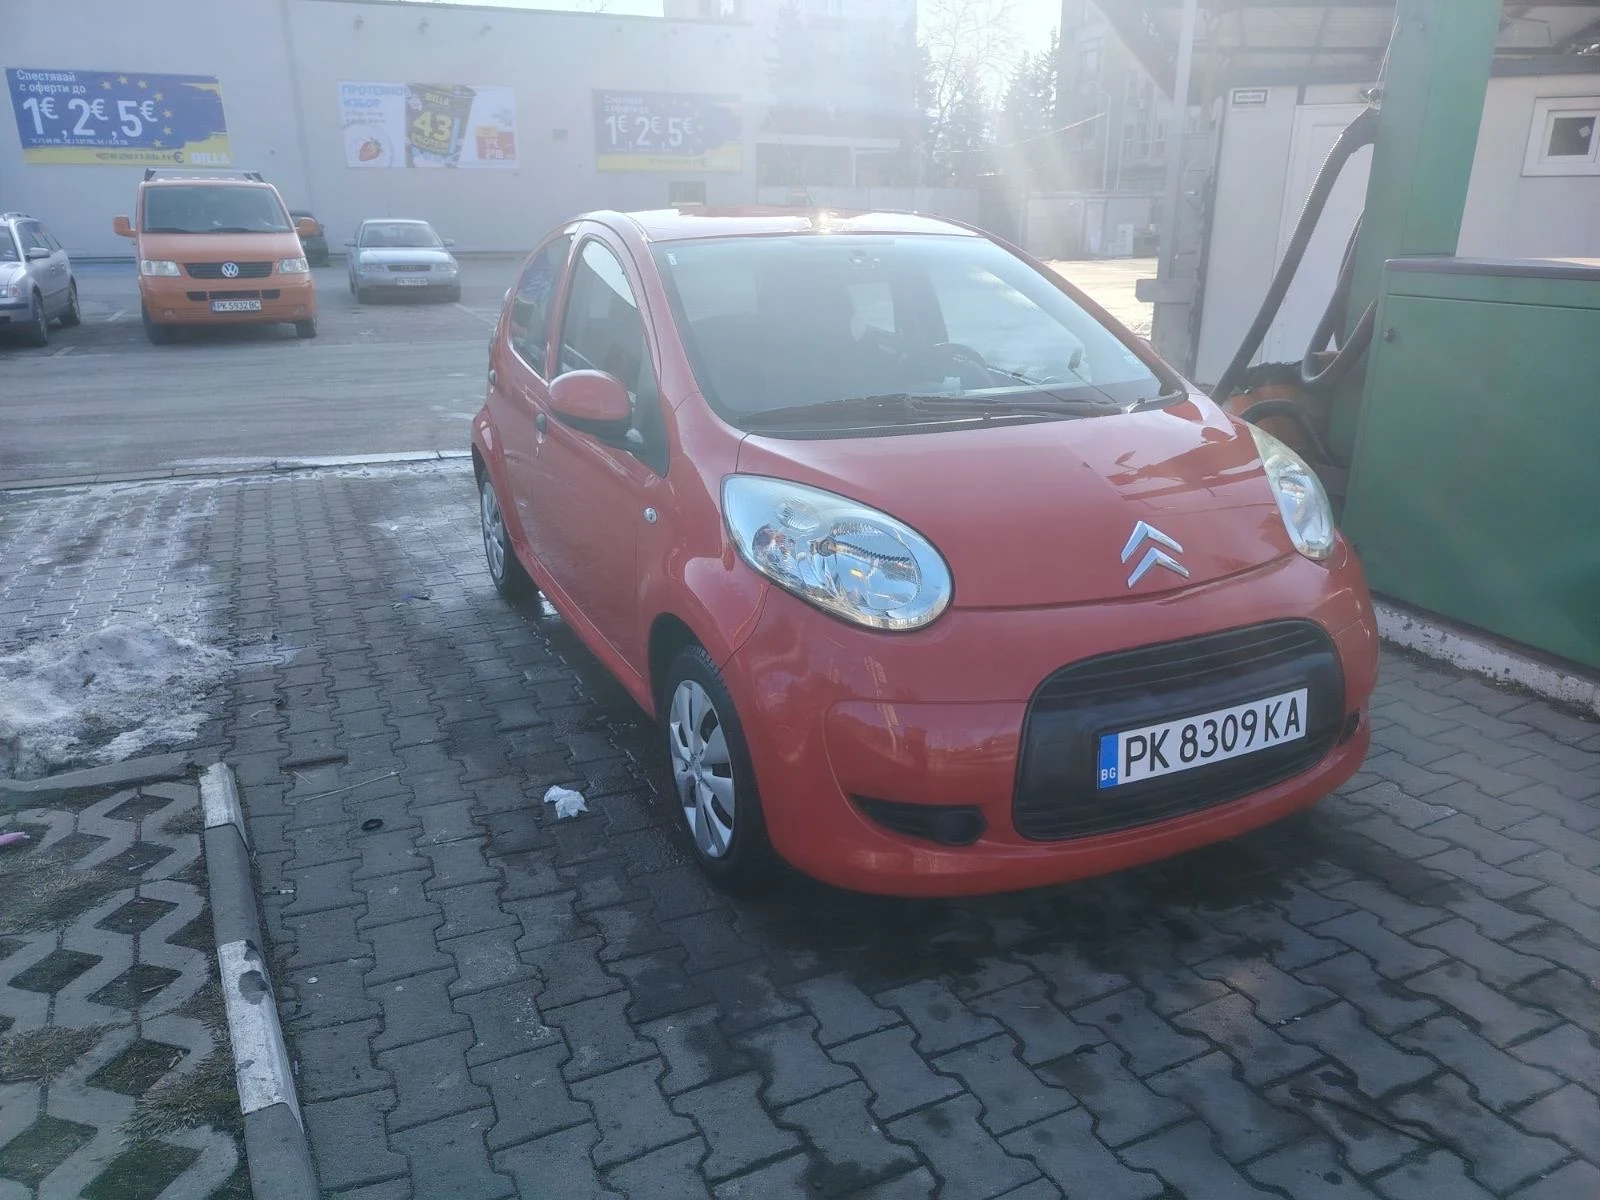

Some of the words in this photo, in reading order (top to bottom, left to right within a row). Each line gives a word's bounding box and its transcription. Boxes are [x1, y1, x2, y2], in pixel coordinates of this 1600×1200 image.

[16, 69, 76, 82] Спестявай
[19, 83, 26, 92] с
[28, 81, 70, 95] оферти
[72, 85, 87, 96] до
[413, 111, 452, 141] 43
[191, 151, 230, 165] BILLA
[1125, 728, 1171, 777] PK
[1179, 709, 1258, 763] 8309
[1264, 697, 1300, 742] KA
[1101, 767, 1117, 781] BG
